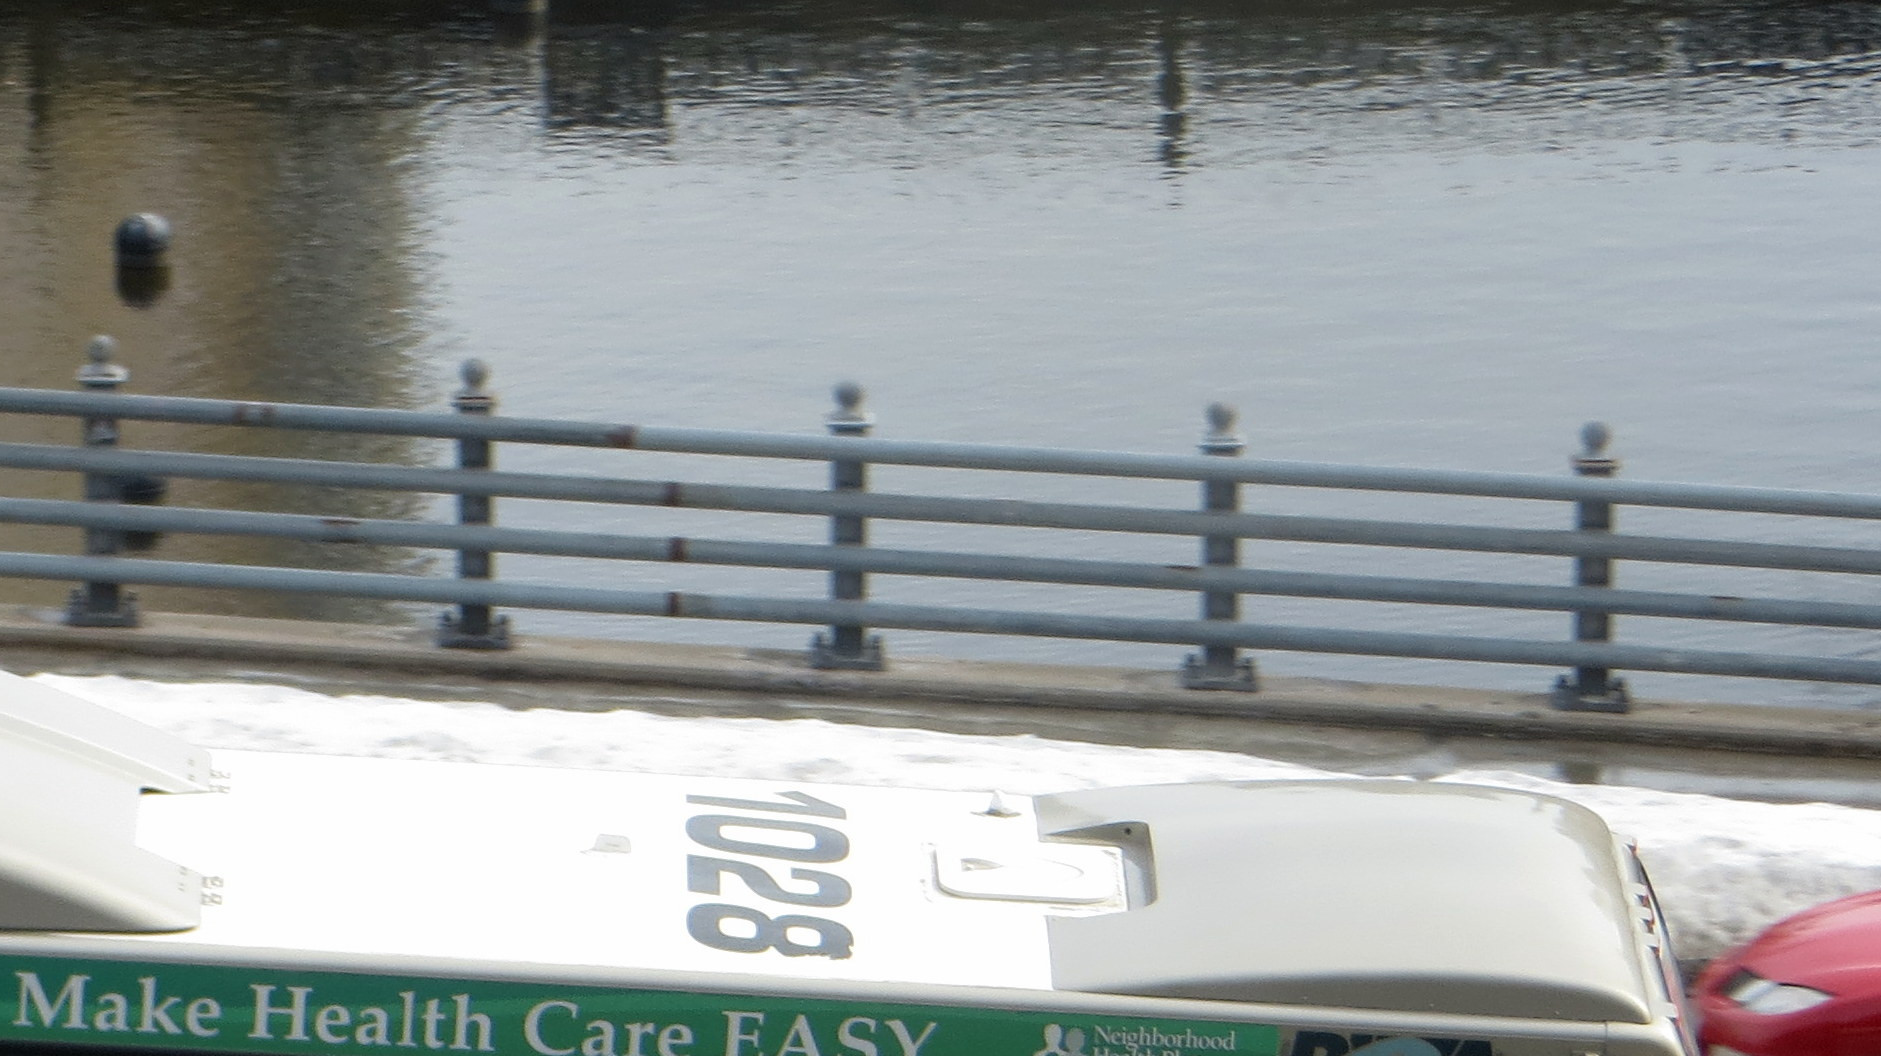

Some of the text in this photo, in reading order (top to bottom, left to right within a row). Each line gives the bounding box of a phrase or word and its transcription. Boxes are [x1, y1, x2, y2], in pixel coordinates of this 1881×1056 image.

[685, 790, 855, 960] 1028
[12, 971, 221, 1037] Make
[247, 984, 496, 1052] Health
[1093, 1024, 1236, 1051] Neighborhood
